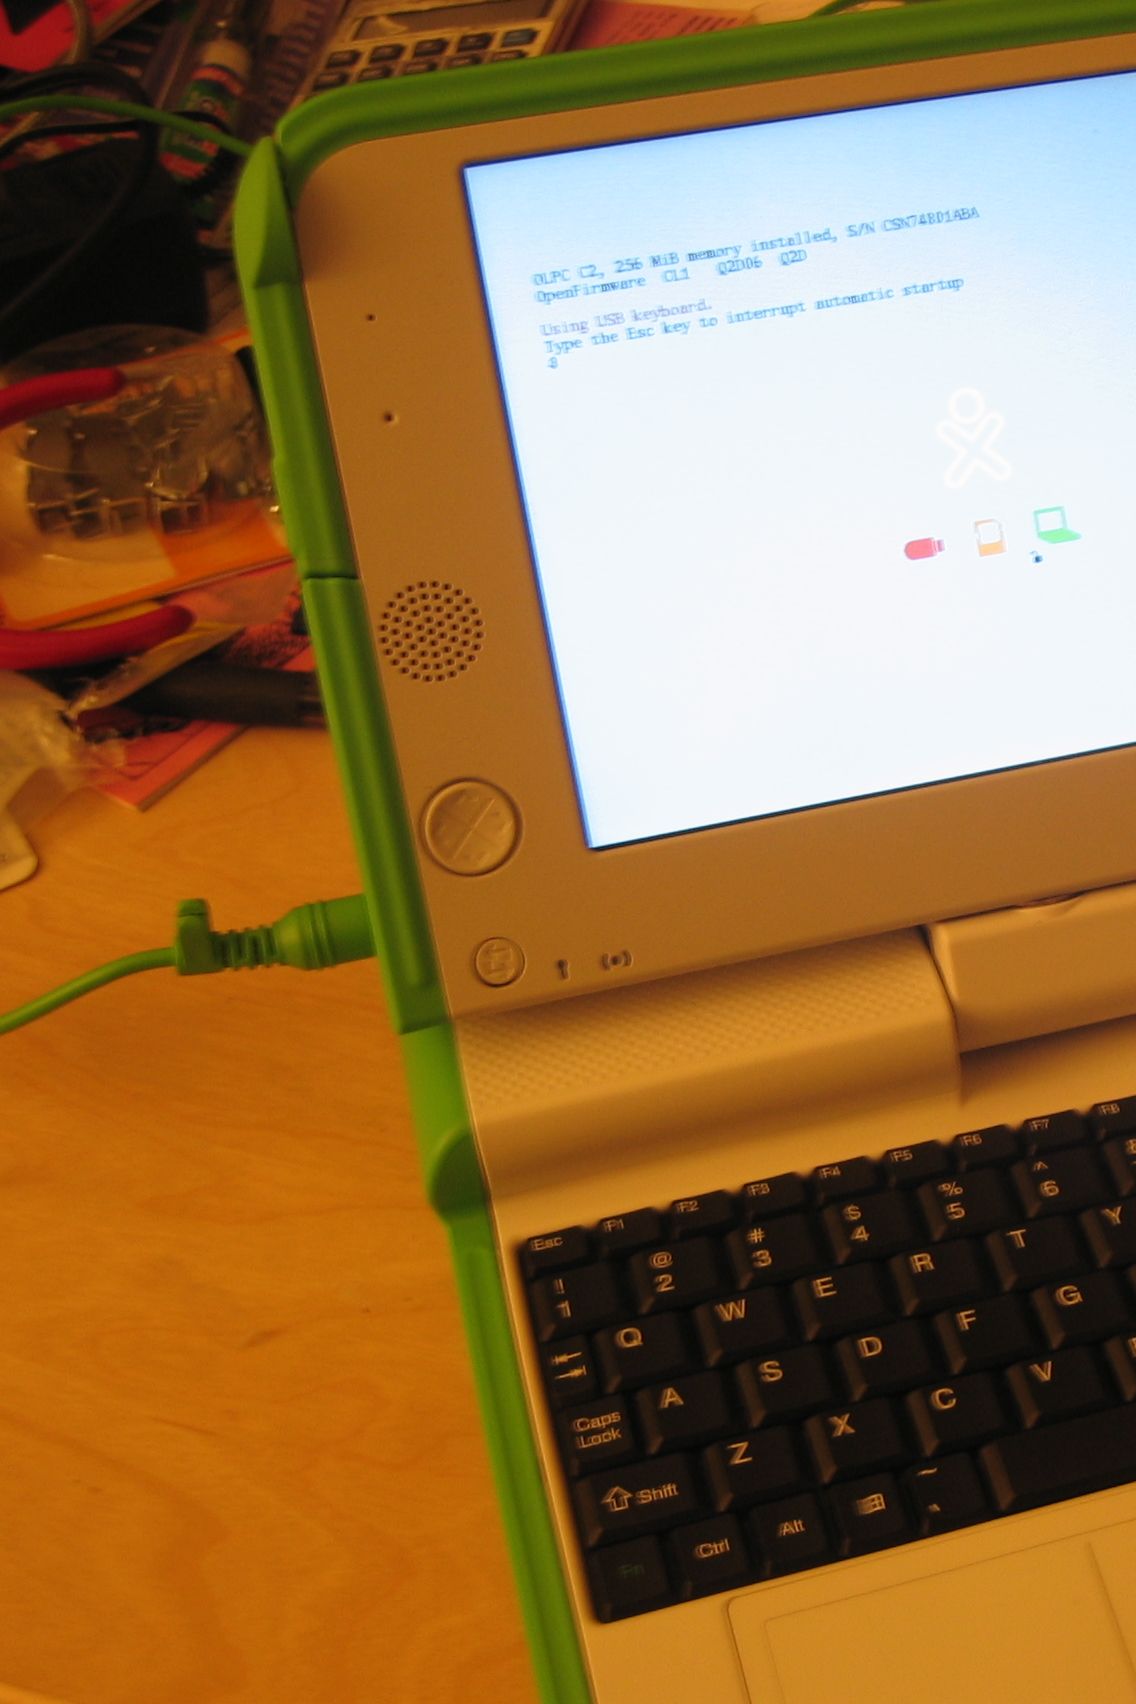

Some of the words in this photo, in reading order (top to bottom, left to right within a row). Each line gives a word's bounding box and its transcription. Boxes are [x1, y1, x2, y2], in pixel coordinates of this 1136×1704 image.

[650, 251, 680, 269] MiB
[688, 243, 742, 264] memory
[751, 226, 838, 254] installed,
[847, 219, 875, 238] S/N
[534, 272, 646, 303] OpenFirmware
[540, 318, 590, 340] Using
[632, 298, 713, 325] keyboard.
[545, 335, 583, 356] Type
[591, 328, 618, 346] the
[625, 323, 656, 341] Esc
[662, 317, 691, 337] key
[700, 312, 718, 329] to
[727, 299, 806, 326] interrupt
[816, 286, 894, 311] automatic
[903, 276, 964, 301] startup
[1030, 1118, 1051, 1134] F7
[960, 1133, 984, 1148] F6
[890, 1149, 914, 1163] F5
[818, 1165, 842, 1181] F4
[937, 1181, 965, 1198] %
[1039, 1179, 1060, 1198] 6
[676, 1199, 700, 1215] F2
[844, 1204, 862, 1221] $
[946, 1201, 967, 1220] 5
[1101, 1205, 1123, 1227] Y
[603, 1217, 625, 1233] F1
[747, 1227, 766, 1244] #
[851, 1224, 870, 1242] 4
[530, 1235, 564, 1252] Esc
[1006, 1228, 1028, 1249] T
[650, 1251, 674, 1269] @
[752, 1249, 774, 1268] 3
[909, 1252, 936, 1275] R
[655, 1274, 676, 1293] 2
[812, 1276, 838, 1299] E
[1055, 1284, 1085, 1307] G
[714, 1298, 748, 1322] W
[956, 1309, 978, 1332] F
[614, 1326, 645, 1350] Q
[856, 1335, 884, 1359] D
[757, 1359, 785, 1384] S
[1029, 1360, 1054, 1383] V
[659, 1386, 685, 1409] A
[930, 1386, 958, 1411] C
[572, 1410, 621, 1433] Caps
[828, 1412, 857, 1437] X
[574, 1428, 623, 1450] Lock
[726, 1441, 753, 1466] Z
[636, 1482, 680, 1505] Shift
[775, 1518, 806, 1539] Alt
[694, 1538, 731, 1560] Ctrl
